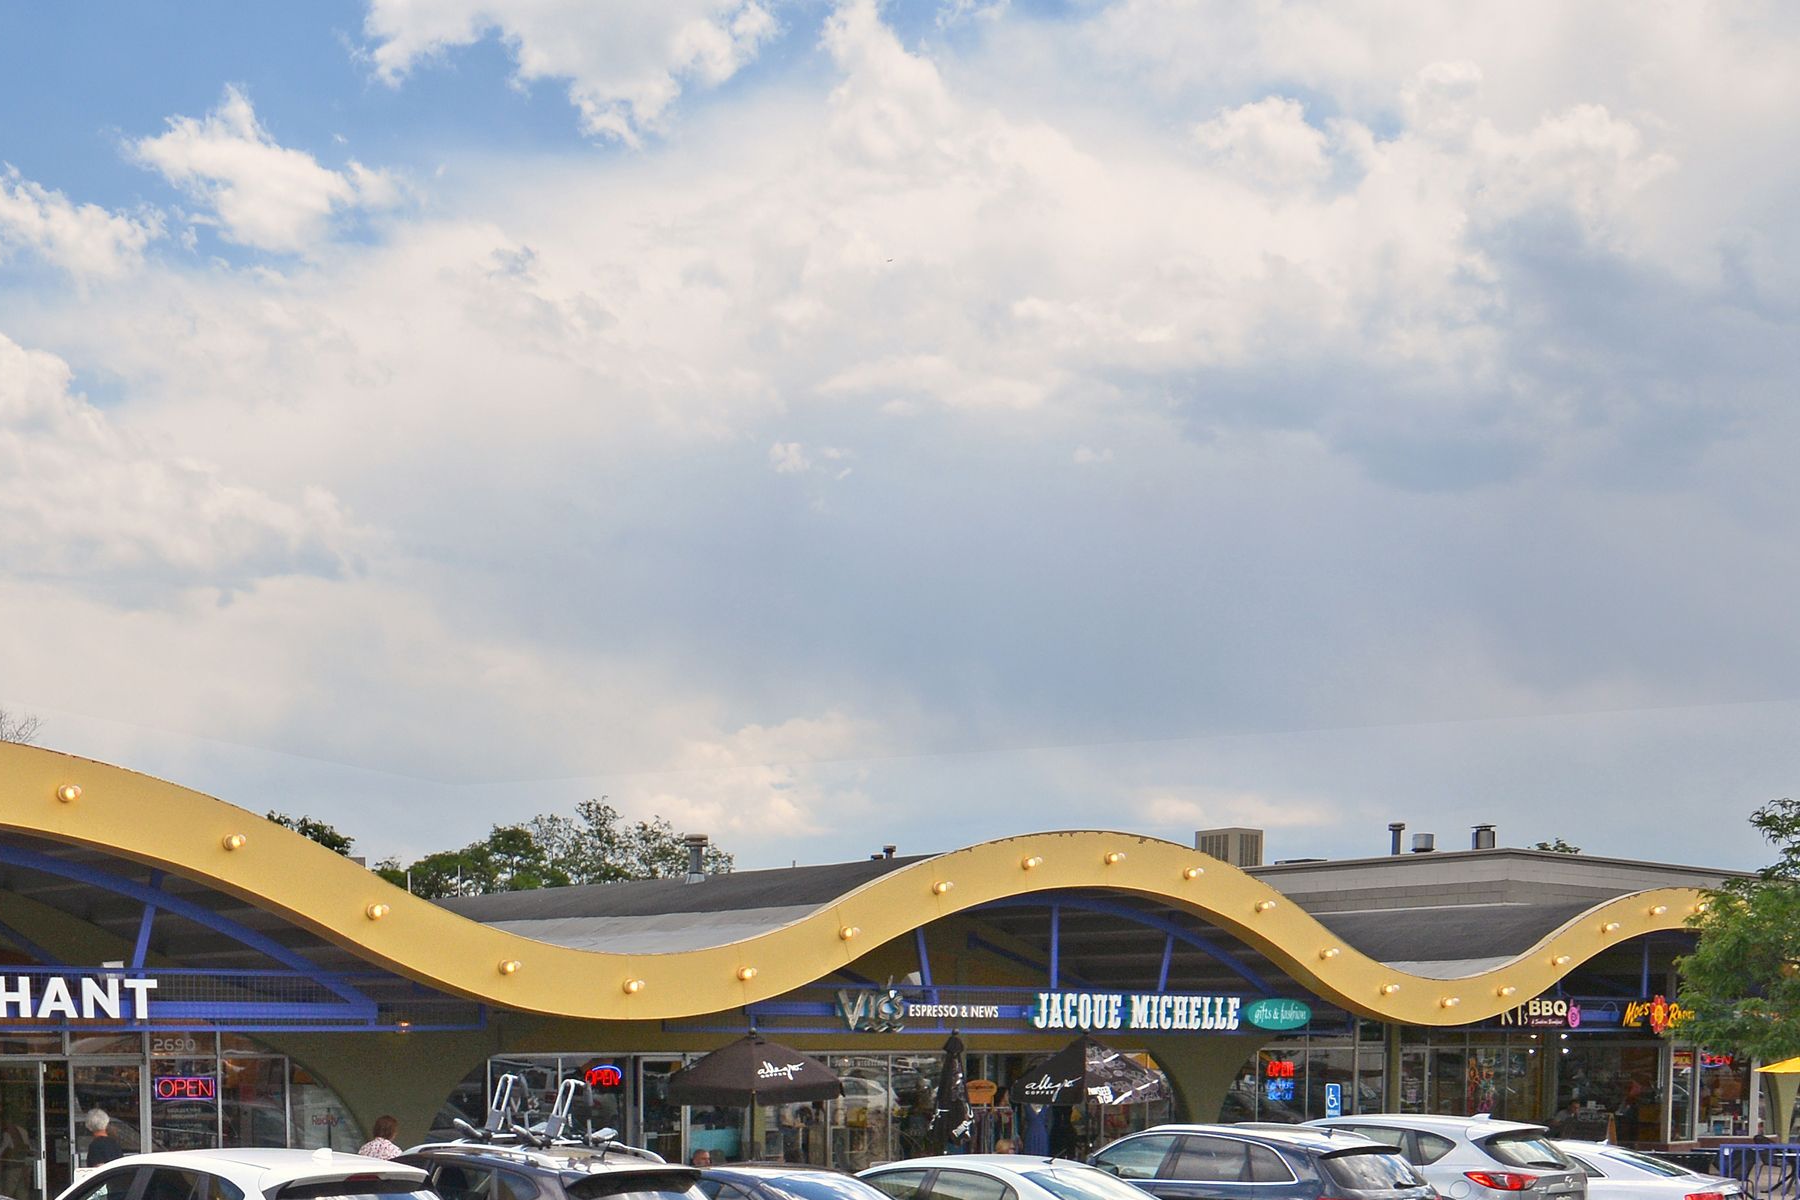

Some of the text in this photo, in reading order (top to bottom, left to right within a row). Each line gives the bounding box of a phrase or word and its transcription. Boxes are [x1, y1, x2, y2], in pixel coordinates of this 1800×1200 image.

[908, 1003, 999, 1018] ESPRESSO & NEWS
[1033, 992, 1241, 1031] JACQUE MICHELLE
[1254, 1001, 1272, 1023] gifts
[1528, 999, 1568, 1017] BBQ
[153, 1038, 196, 1052] 2690
[585, 1069, 619, 1086] OPEN
[158, 1079, 212, 1098] OPEN
